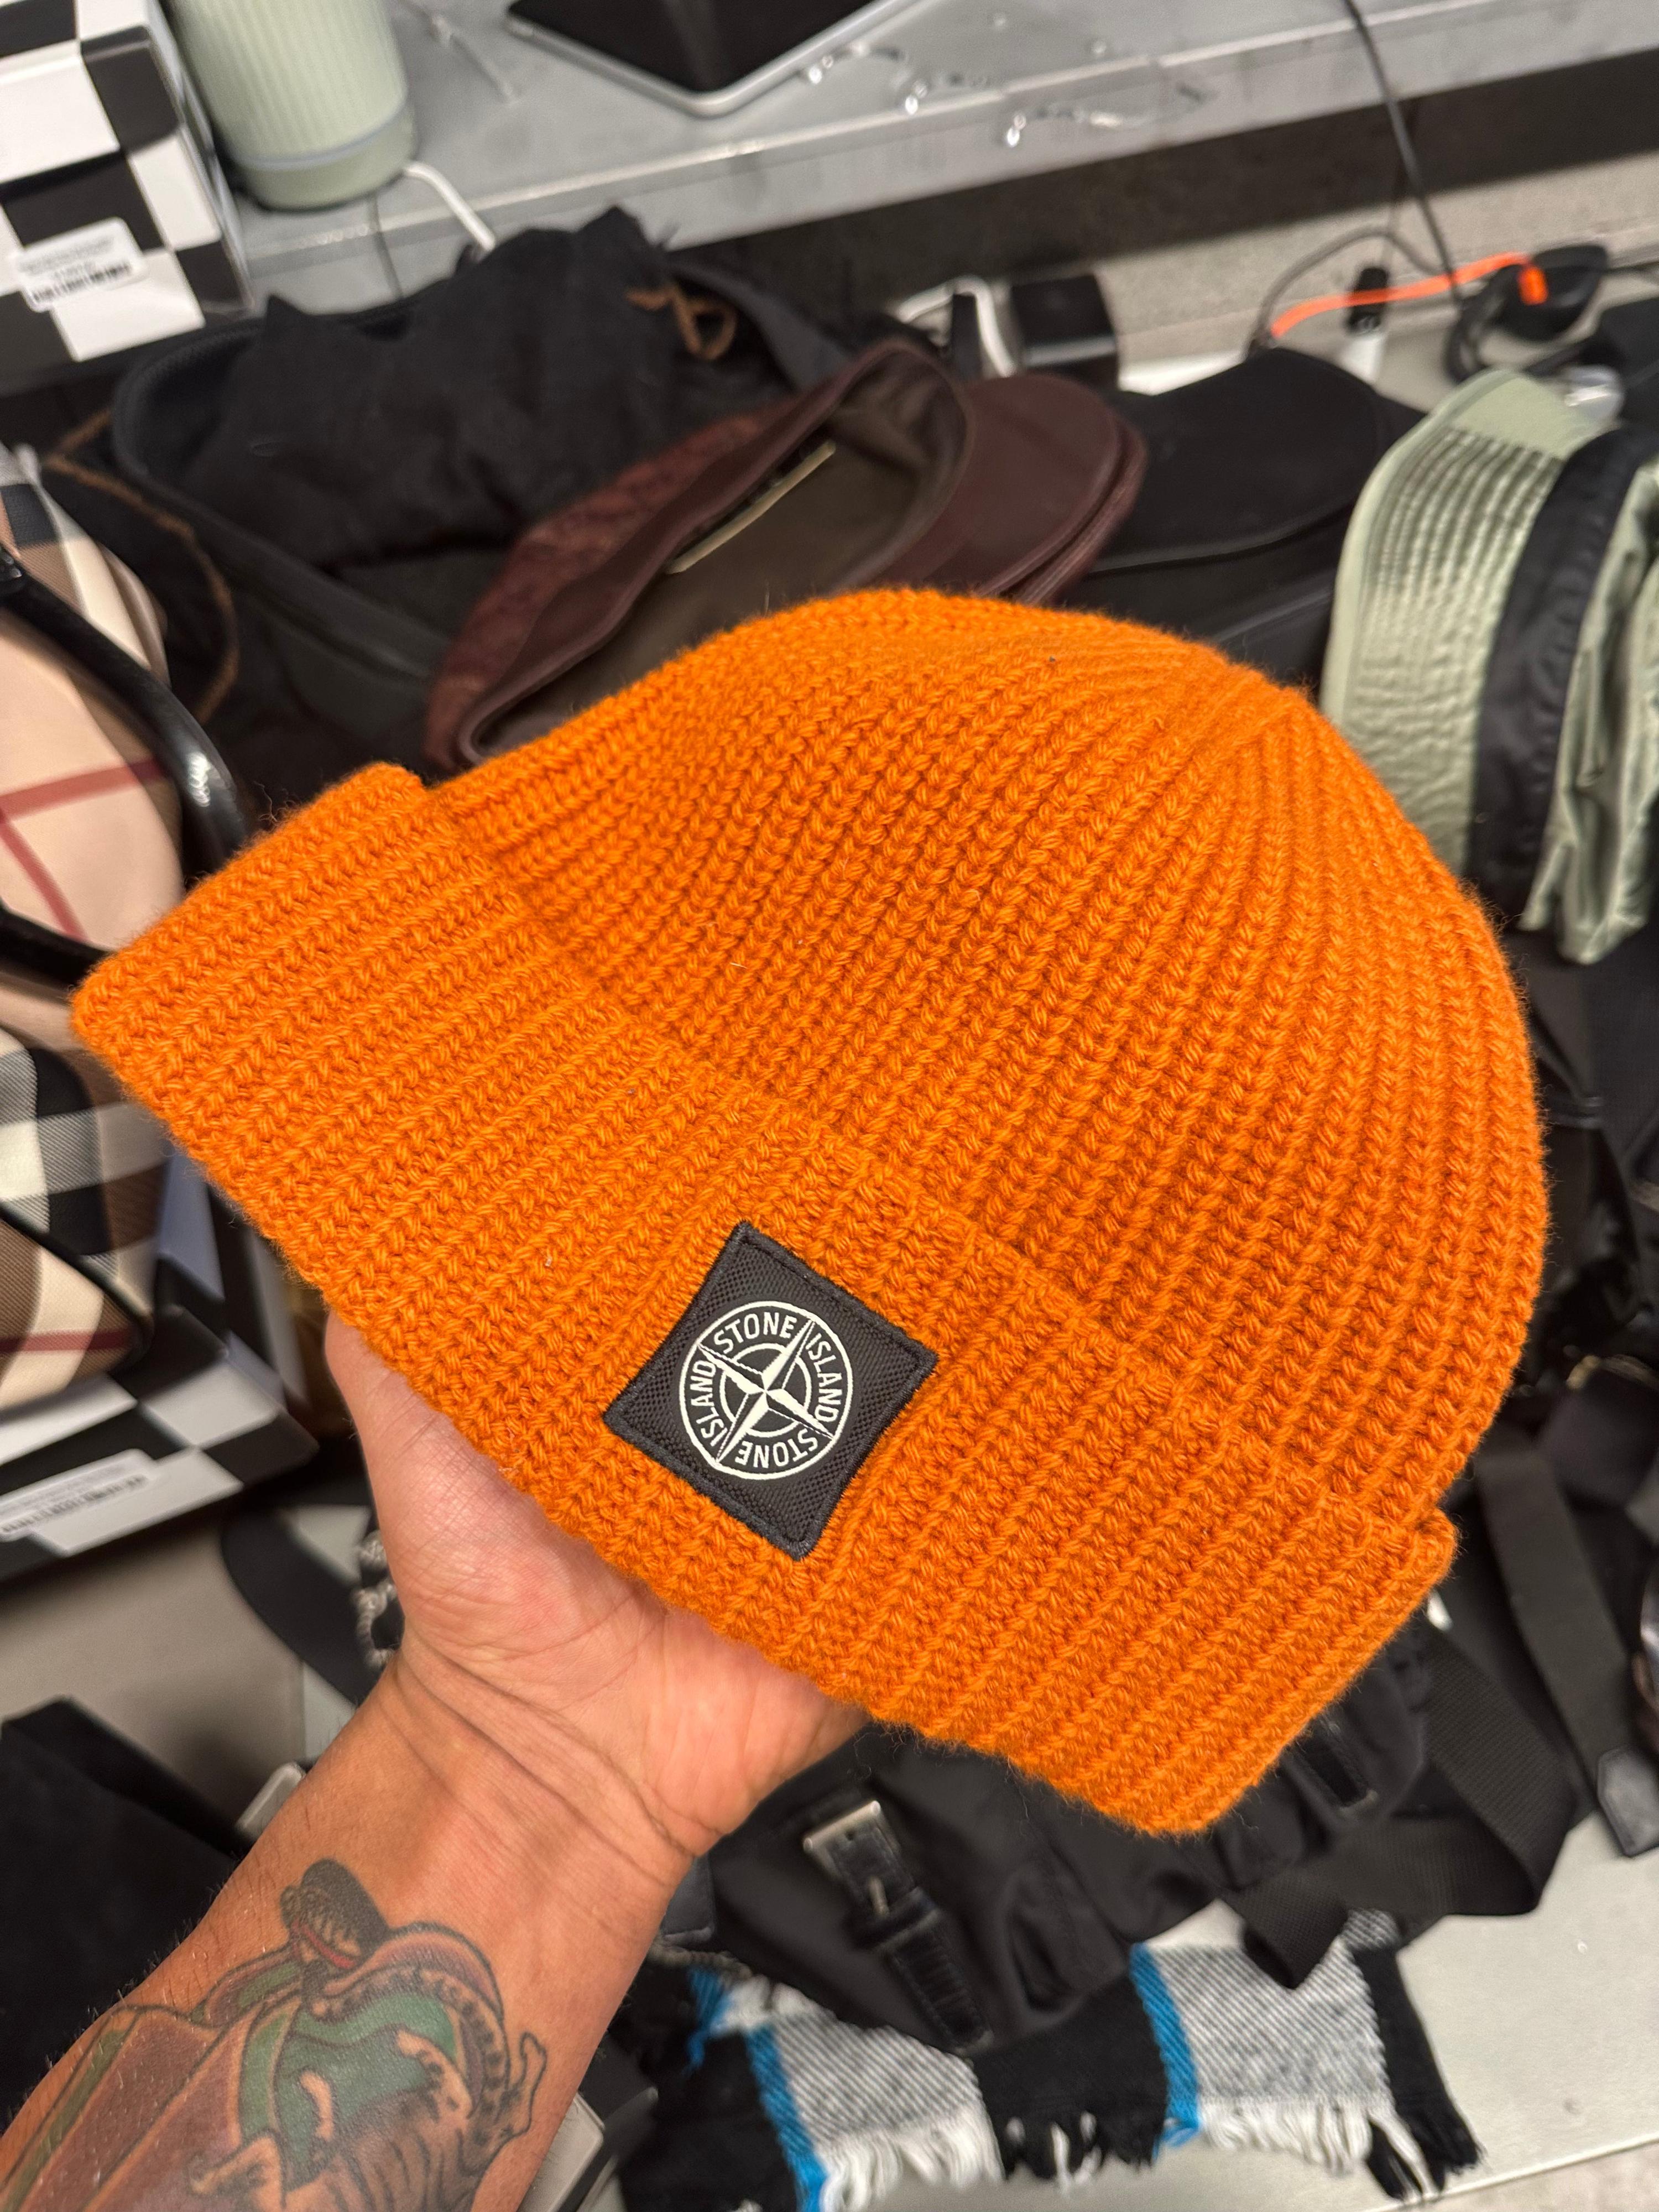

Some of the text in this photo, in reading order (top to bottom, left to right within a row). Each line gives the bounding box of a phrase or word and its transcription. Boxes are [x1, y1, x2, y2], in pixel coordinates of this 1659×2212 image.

[690, 1360, 818, 1469] STONE ISLAND
[714, 1312, 842, 1423] STONE ISLAND
